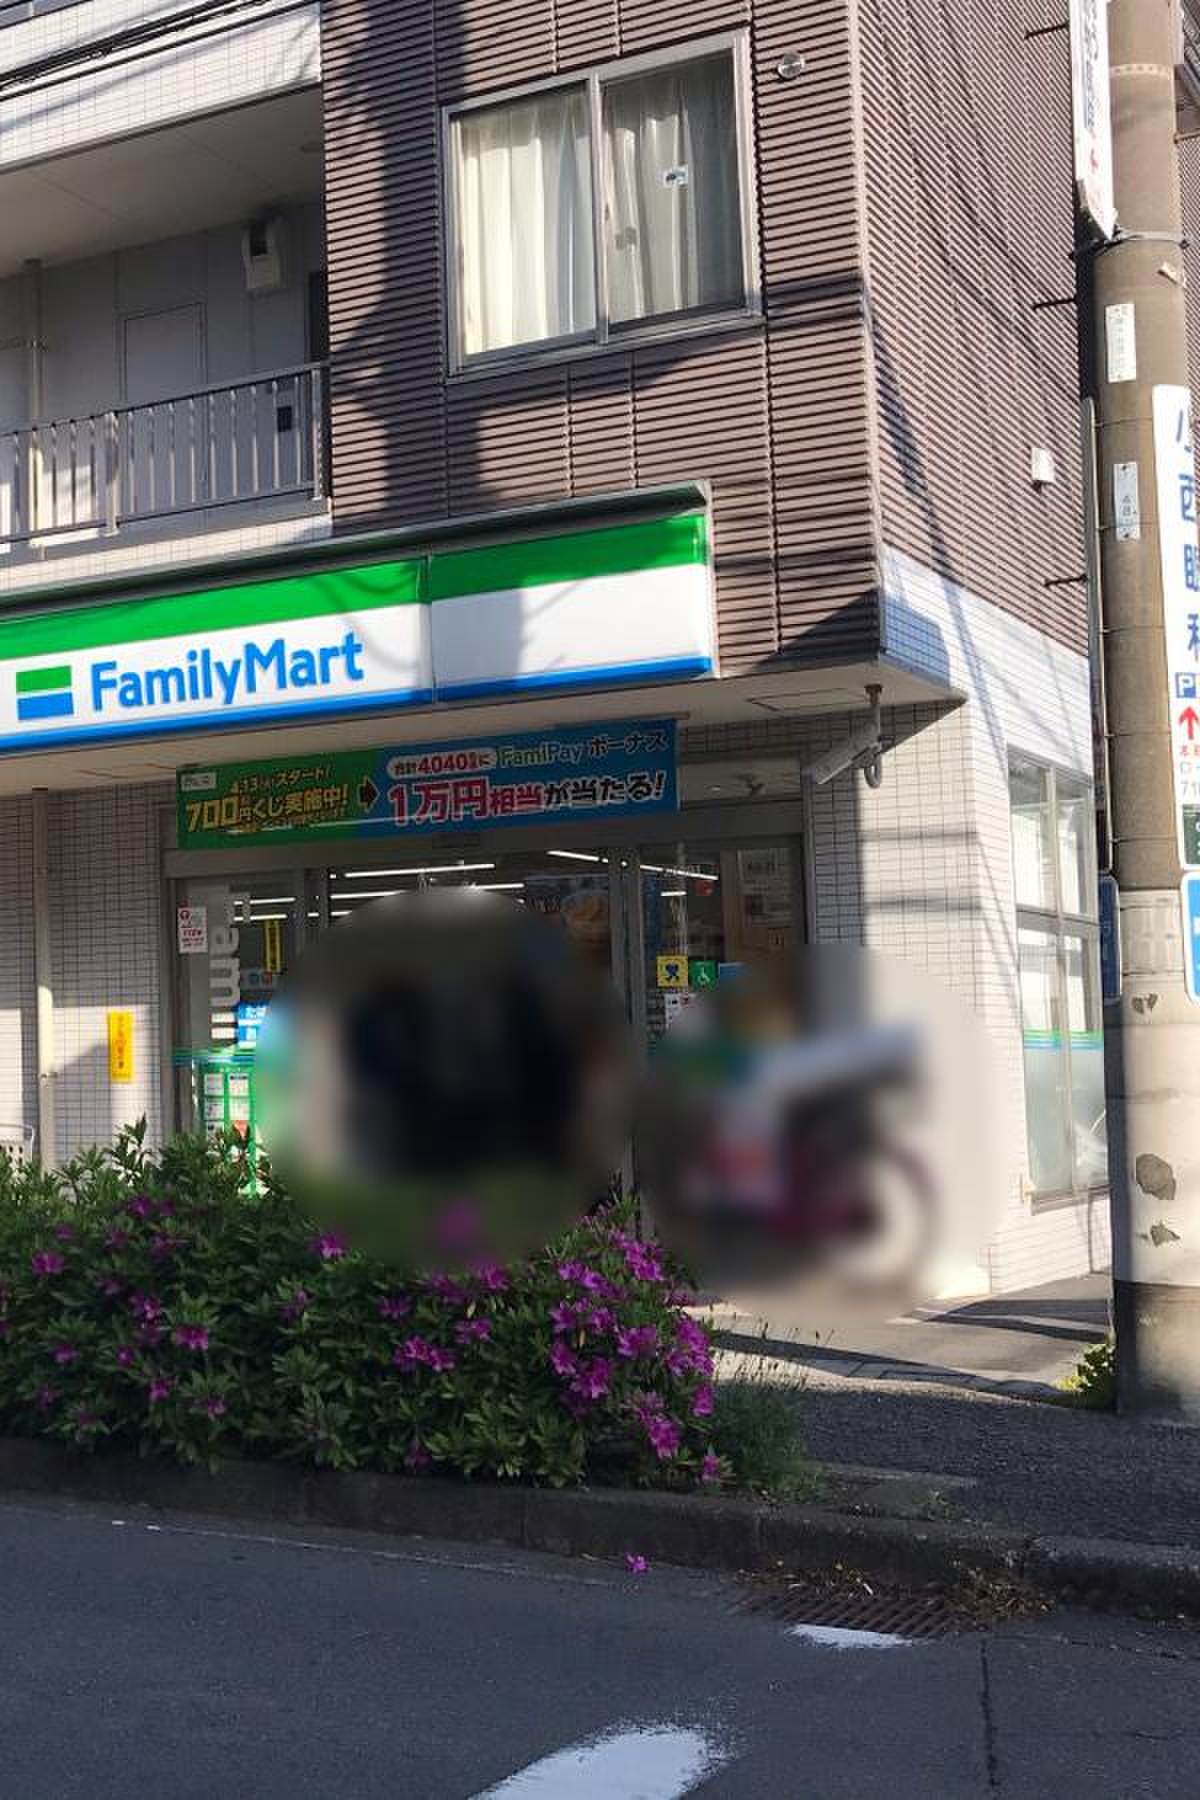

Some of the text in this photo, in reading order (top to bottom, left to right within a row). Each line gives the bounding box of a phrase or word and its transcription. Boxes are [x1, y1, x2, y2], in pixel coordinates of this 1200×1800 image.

[90, 632, 365, 712] FamilyMart
[588, 732, 668, 758] ボーナス
